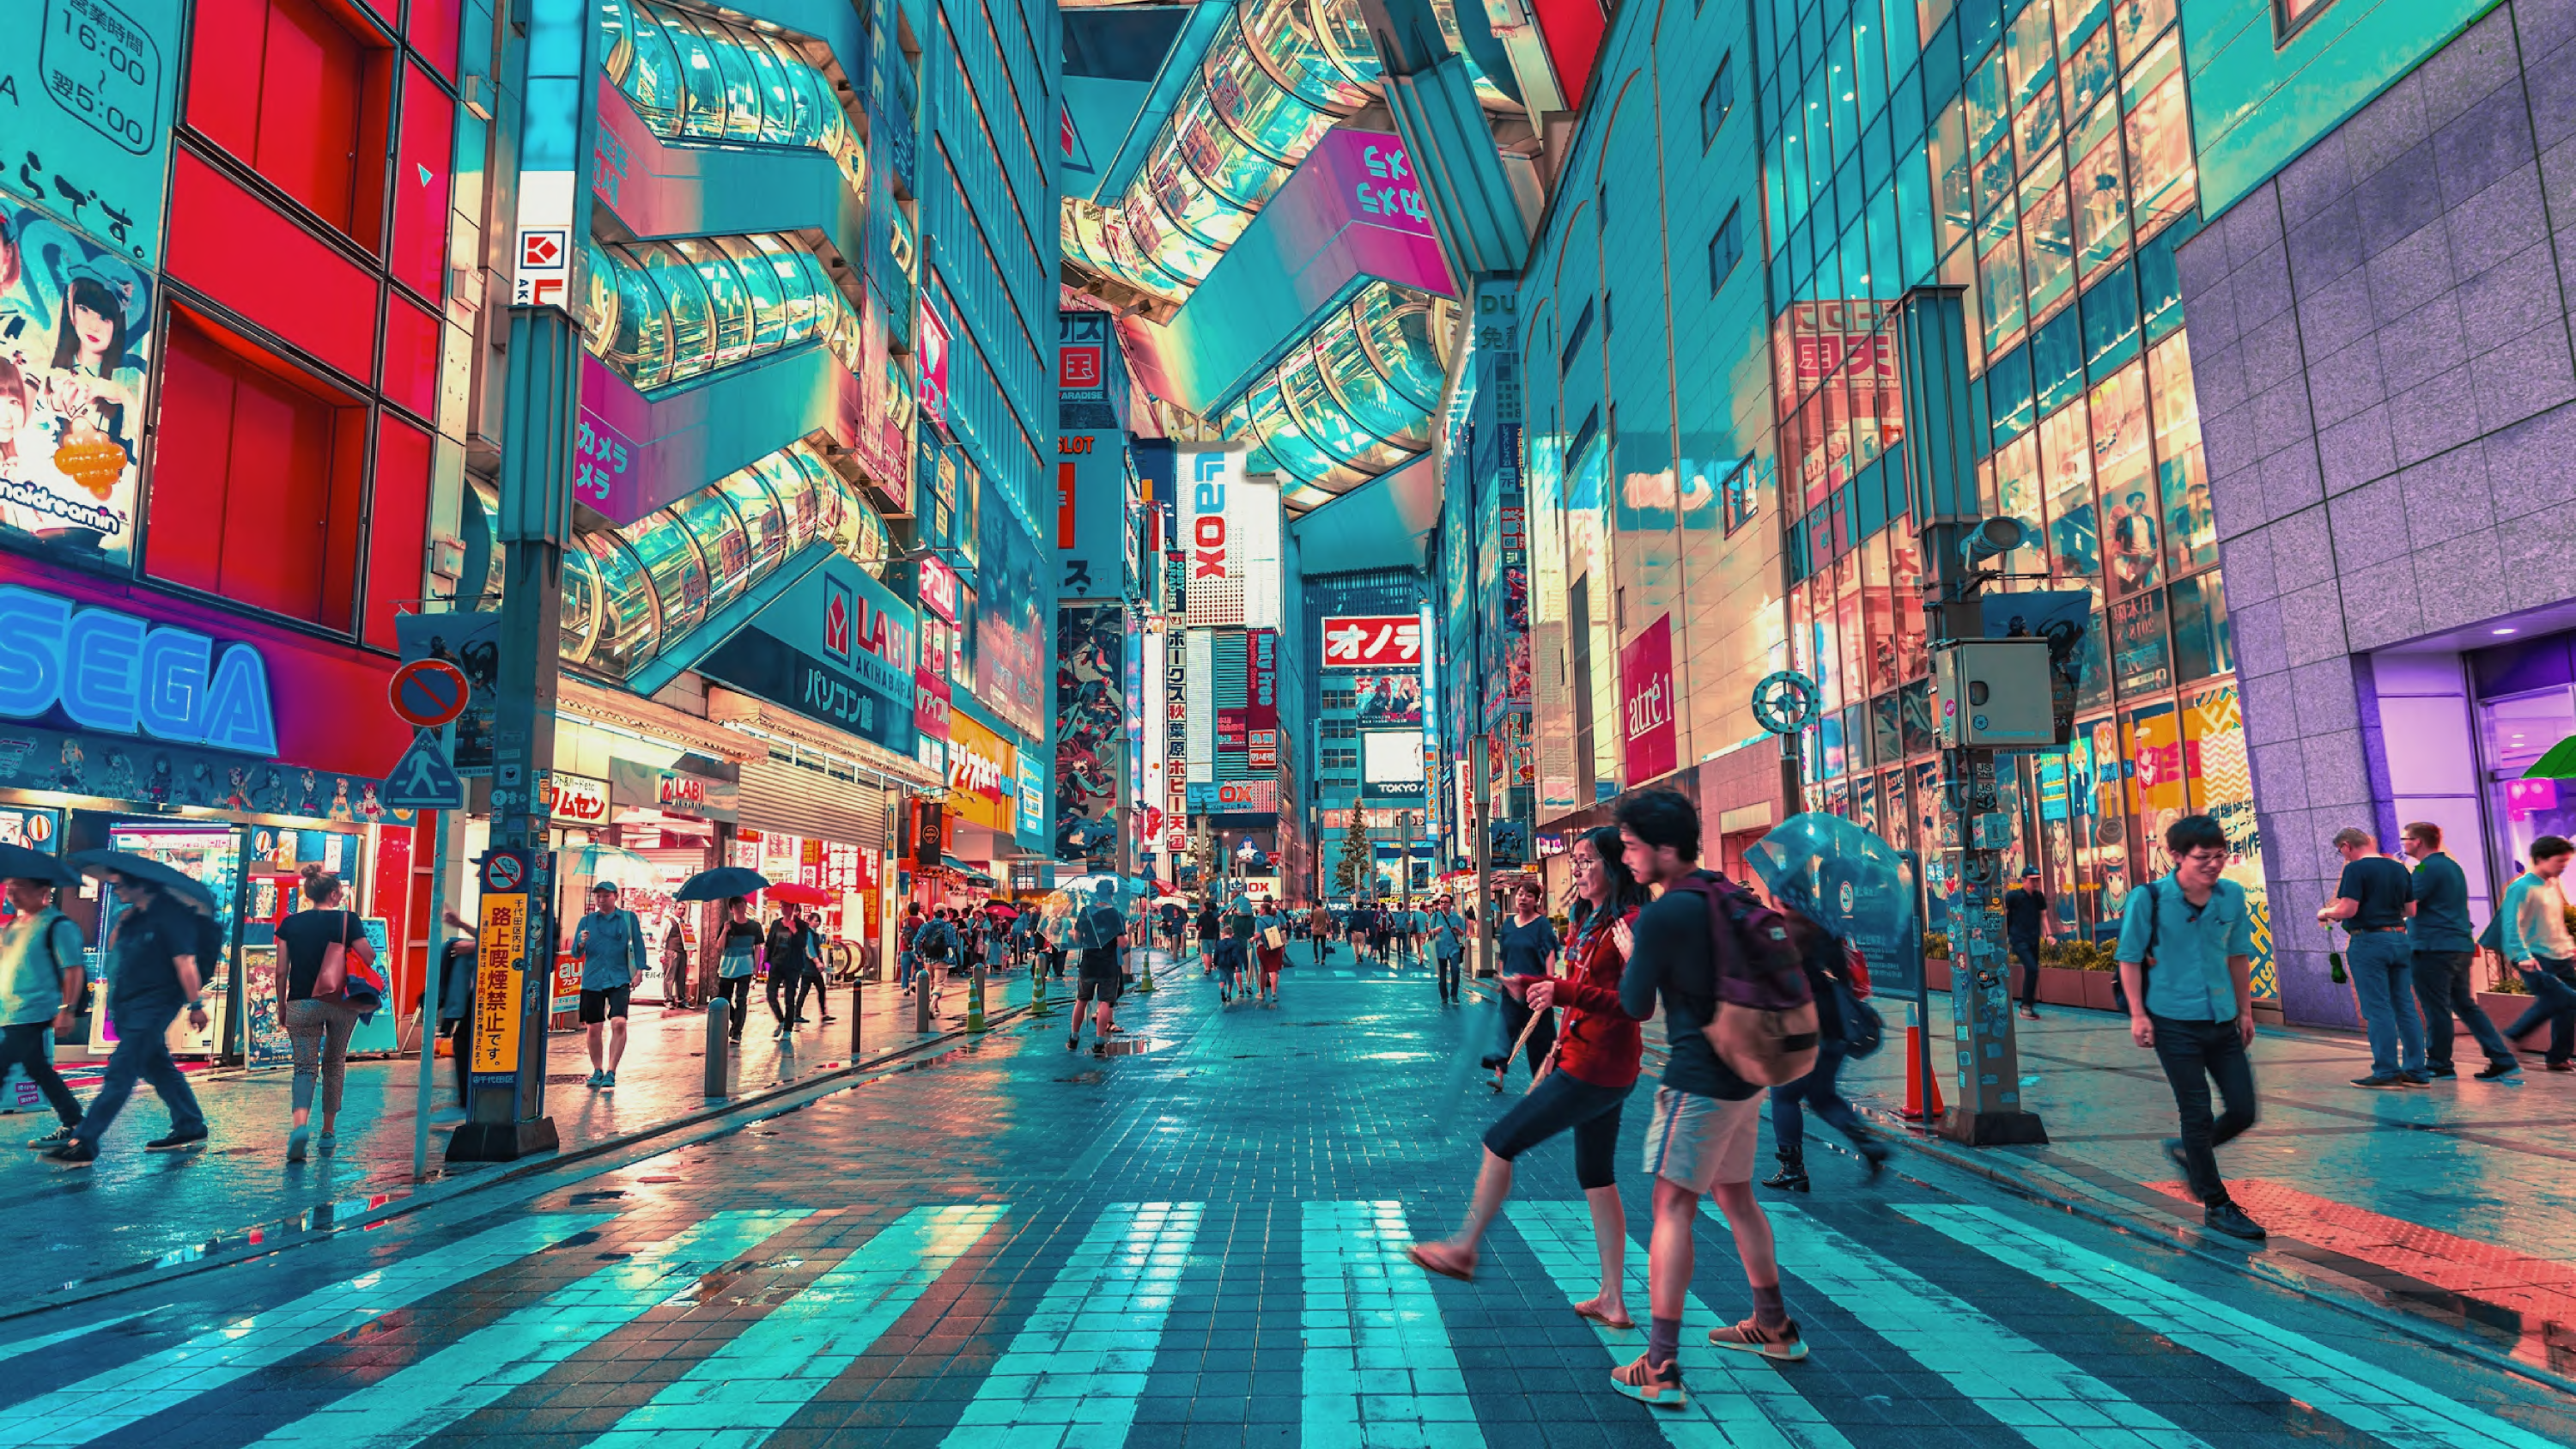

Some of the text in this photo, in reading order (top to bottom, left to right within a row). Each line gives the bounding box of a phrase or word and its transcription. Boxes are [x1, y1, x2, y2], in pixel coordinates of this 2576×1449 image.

[63, 8, 146, 86] 16:00
[578, 421, 629, 474] カメラ
[1501, 478, 1514, 488] 7F
[920, 557, 955, 614] アコム
[1168, 552, 1177, 610] PARADISE
[1176, 552, 1185, 592] HOBBY
[857, 595, 914, 677] LABI
[0, 584, 278, 759] SEGA
[856, 655, 913, 703] AKIHABARA
[1257, 633, 1276, 706] Duty Free
[1629, 673, 1662, 737] atré
[675, 777, 707, 801] LABI
[1378, 783, 1418, 793] TOKYO
[512, 899, 524, 953] 千代田区内は
[485, 907, 512, 1067] 路上喫煙禁止です。
[559, 961, 583, 978] au
